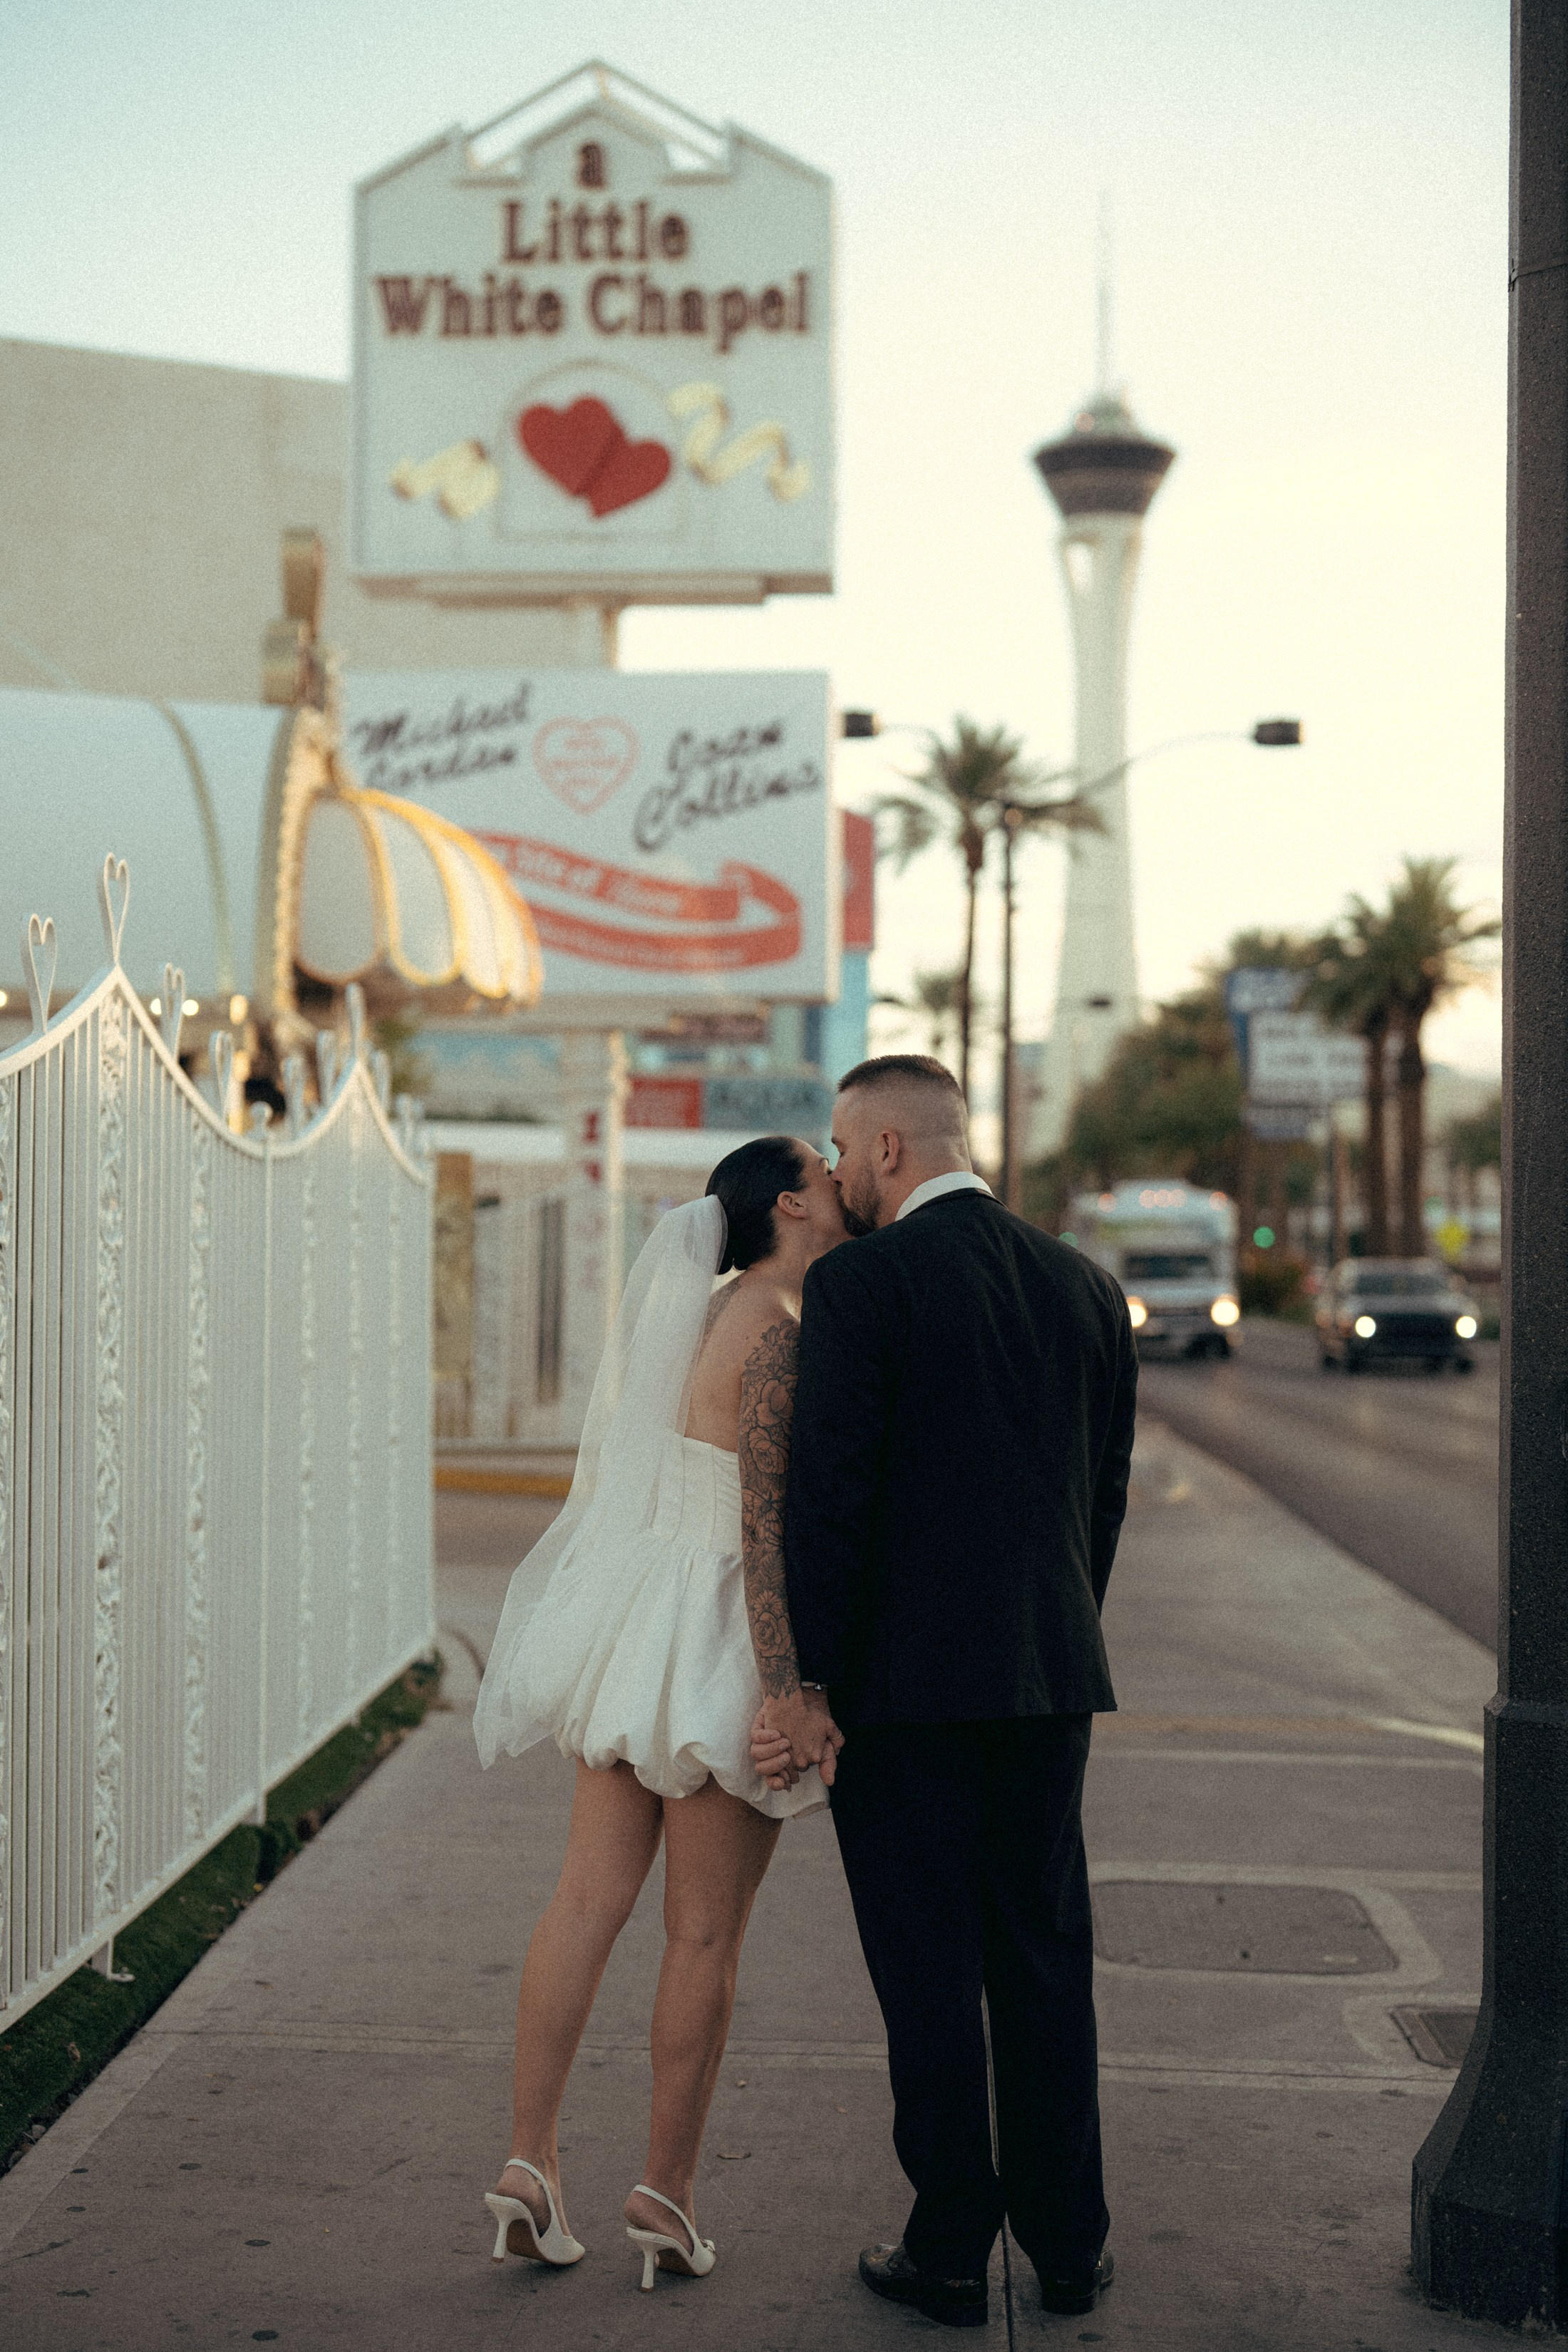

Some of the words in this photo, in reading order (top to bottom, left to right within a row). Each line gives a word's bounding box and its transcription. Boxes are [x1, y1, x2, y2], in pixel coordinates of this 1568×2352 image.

[502, 196, 690, 264] Little
[374, 273, 564, 338] White
[587, 269, 810, 354] Chapel
[351, 681, 532, 755] Michael
[634, 760, 822, 853] Collins
